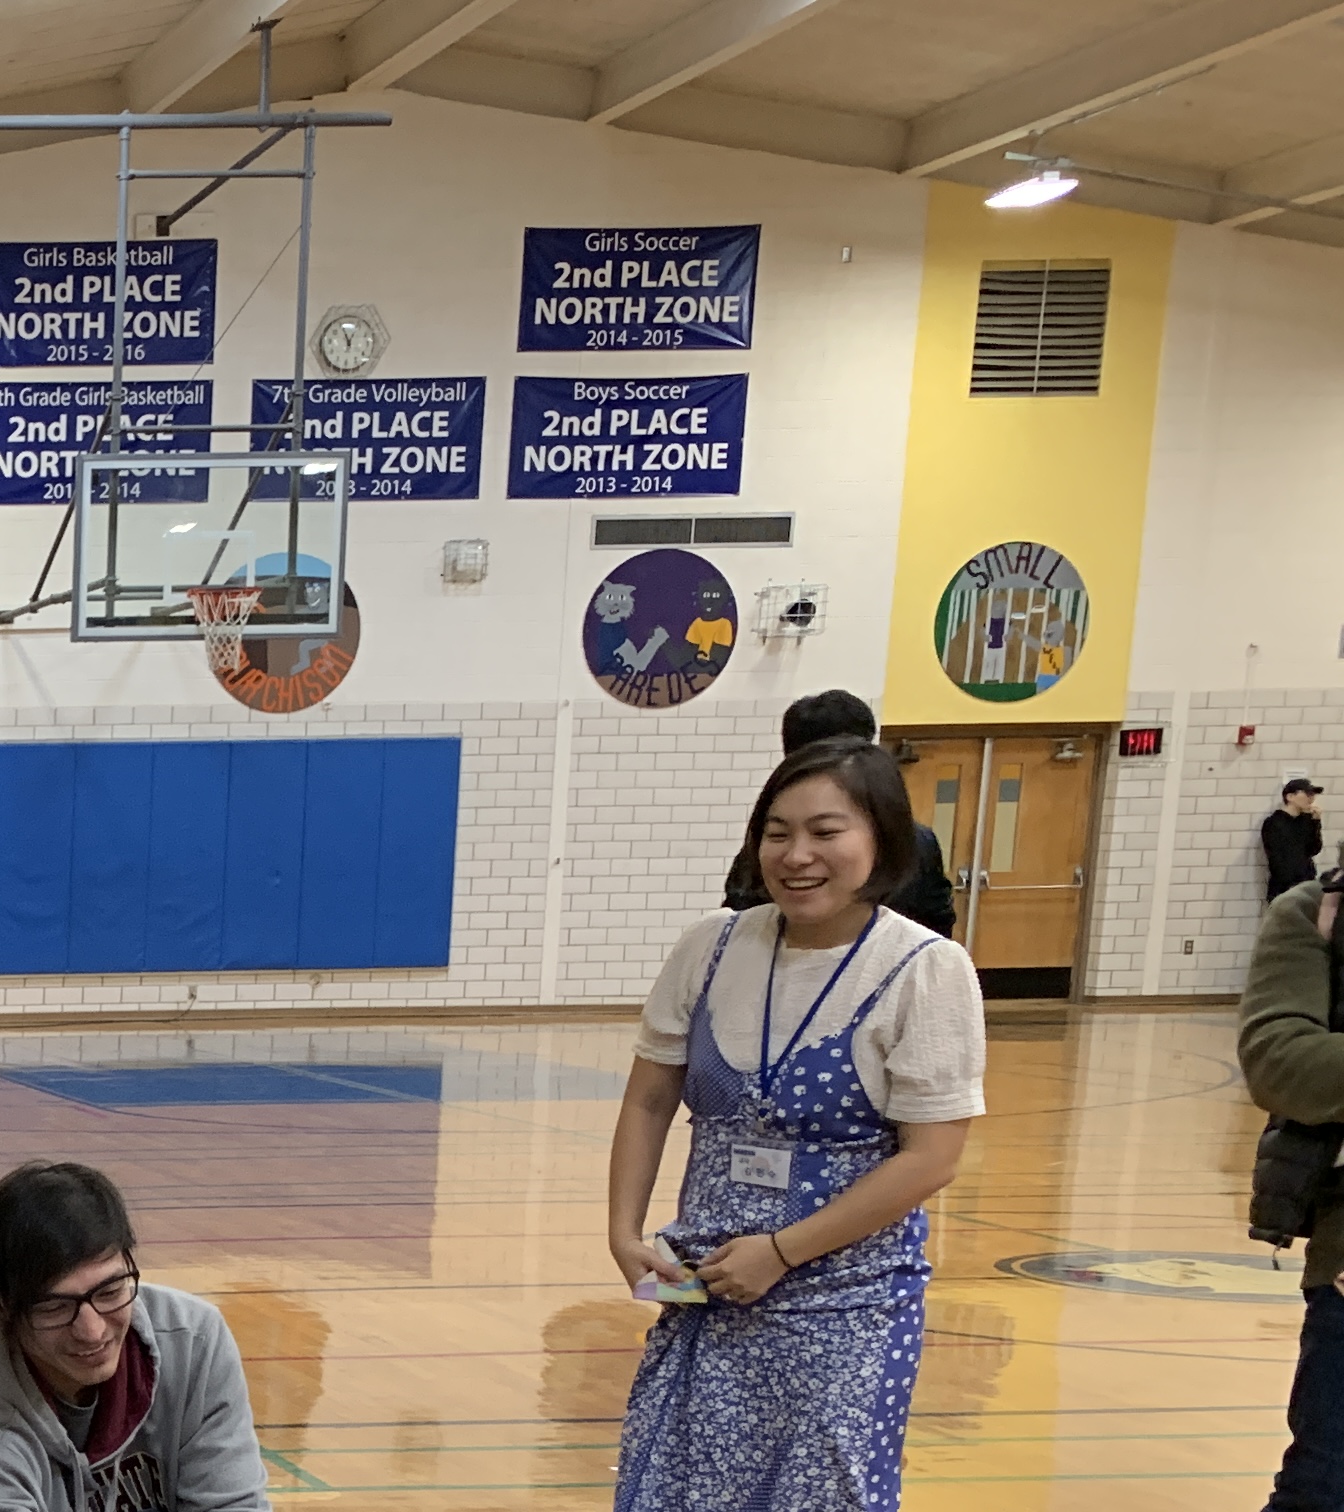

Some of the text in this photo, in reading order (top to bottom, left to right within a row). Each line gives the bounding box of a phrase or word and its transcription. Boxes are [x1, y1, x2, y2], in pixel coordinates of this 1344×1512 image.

[585, 232, 699, 251] Girls Soccer
[24, 248, 67, 266] Girls
[552, 259, 719, 288] 2nd PLACE
[14, 275, 181, 304] 2nd PLACE
[534, 296, 740, 324] NORTH ZONE
[122, 311, 200, 337] ZONE
[586, 330, 627, 346] 2014
[642, 329, 684, 345] 2015
[47, 346, 88, 361] 2015
[103, 344, 145, 360] 216
[20, 388, 71, 406] Grade
[75, 387, 112, 406] Girls
[309, 384, 367, 403] Grade
[371, 382, 466, 407] Volleyball
[574, 381, 689, 404] Boys Soccer
[7, 414, 67, 442] 2nd
[352, 411, 449, 438] PLACE
[542, 407, 708, 437] 2nd PLACE
[380, 446, 466, 474] ZONE
[524, 443, 728, 472] NORTH ZONE
[44, 483, 73, 499] 201
[99, 482, 141, 498] 214
[316, 480, 356, 496] 203
[371, 479, 412, 495] 2014
[575, 477, 616, 493] 2013
[631, 476, 672, 492] 2014
[966, 542, 1063, 589] SMALL
[601, 650, 721, 706] PAREDES
